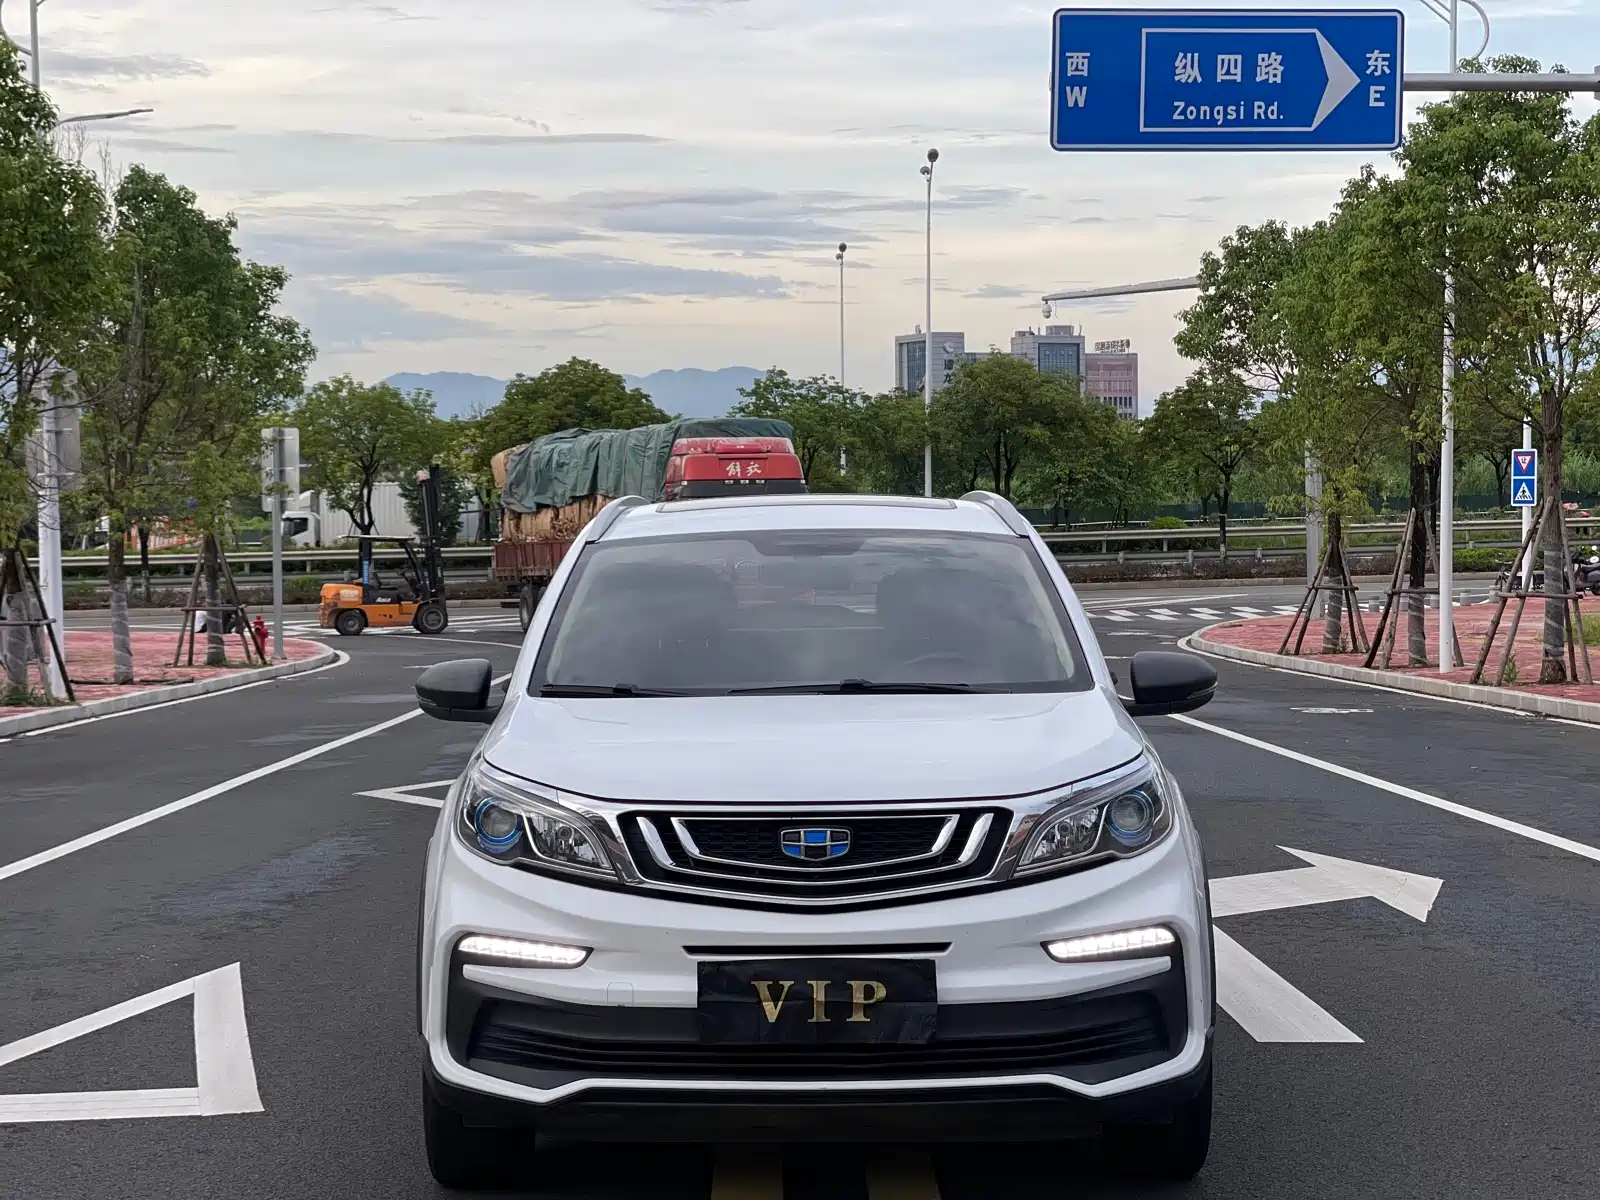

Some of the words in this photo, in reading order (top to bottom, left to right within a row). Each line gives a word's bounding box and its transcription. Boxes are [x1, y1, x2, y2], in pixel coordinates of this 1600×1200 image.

[1065, 52, 1090, 77] 西
[1174, 51, 1285, 84] 纵四路
[1365, 49, 1392, 76] 东
[1066, 86, 1088, 108] W
[1369, 86, 1386, 107] E
[1172, 101, 1245, 125] Zongsi
[1254, 101, 1285, 120] Rd.
[751, 980, 887, 1023] VIP
